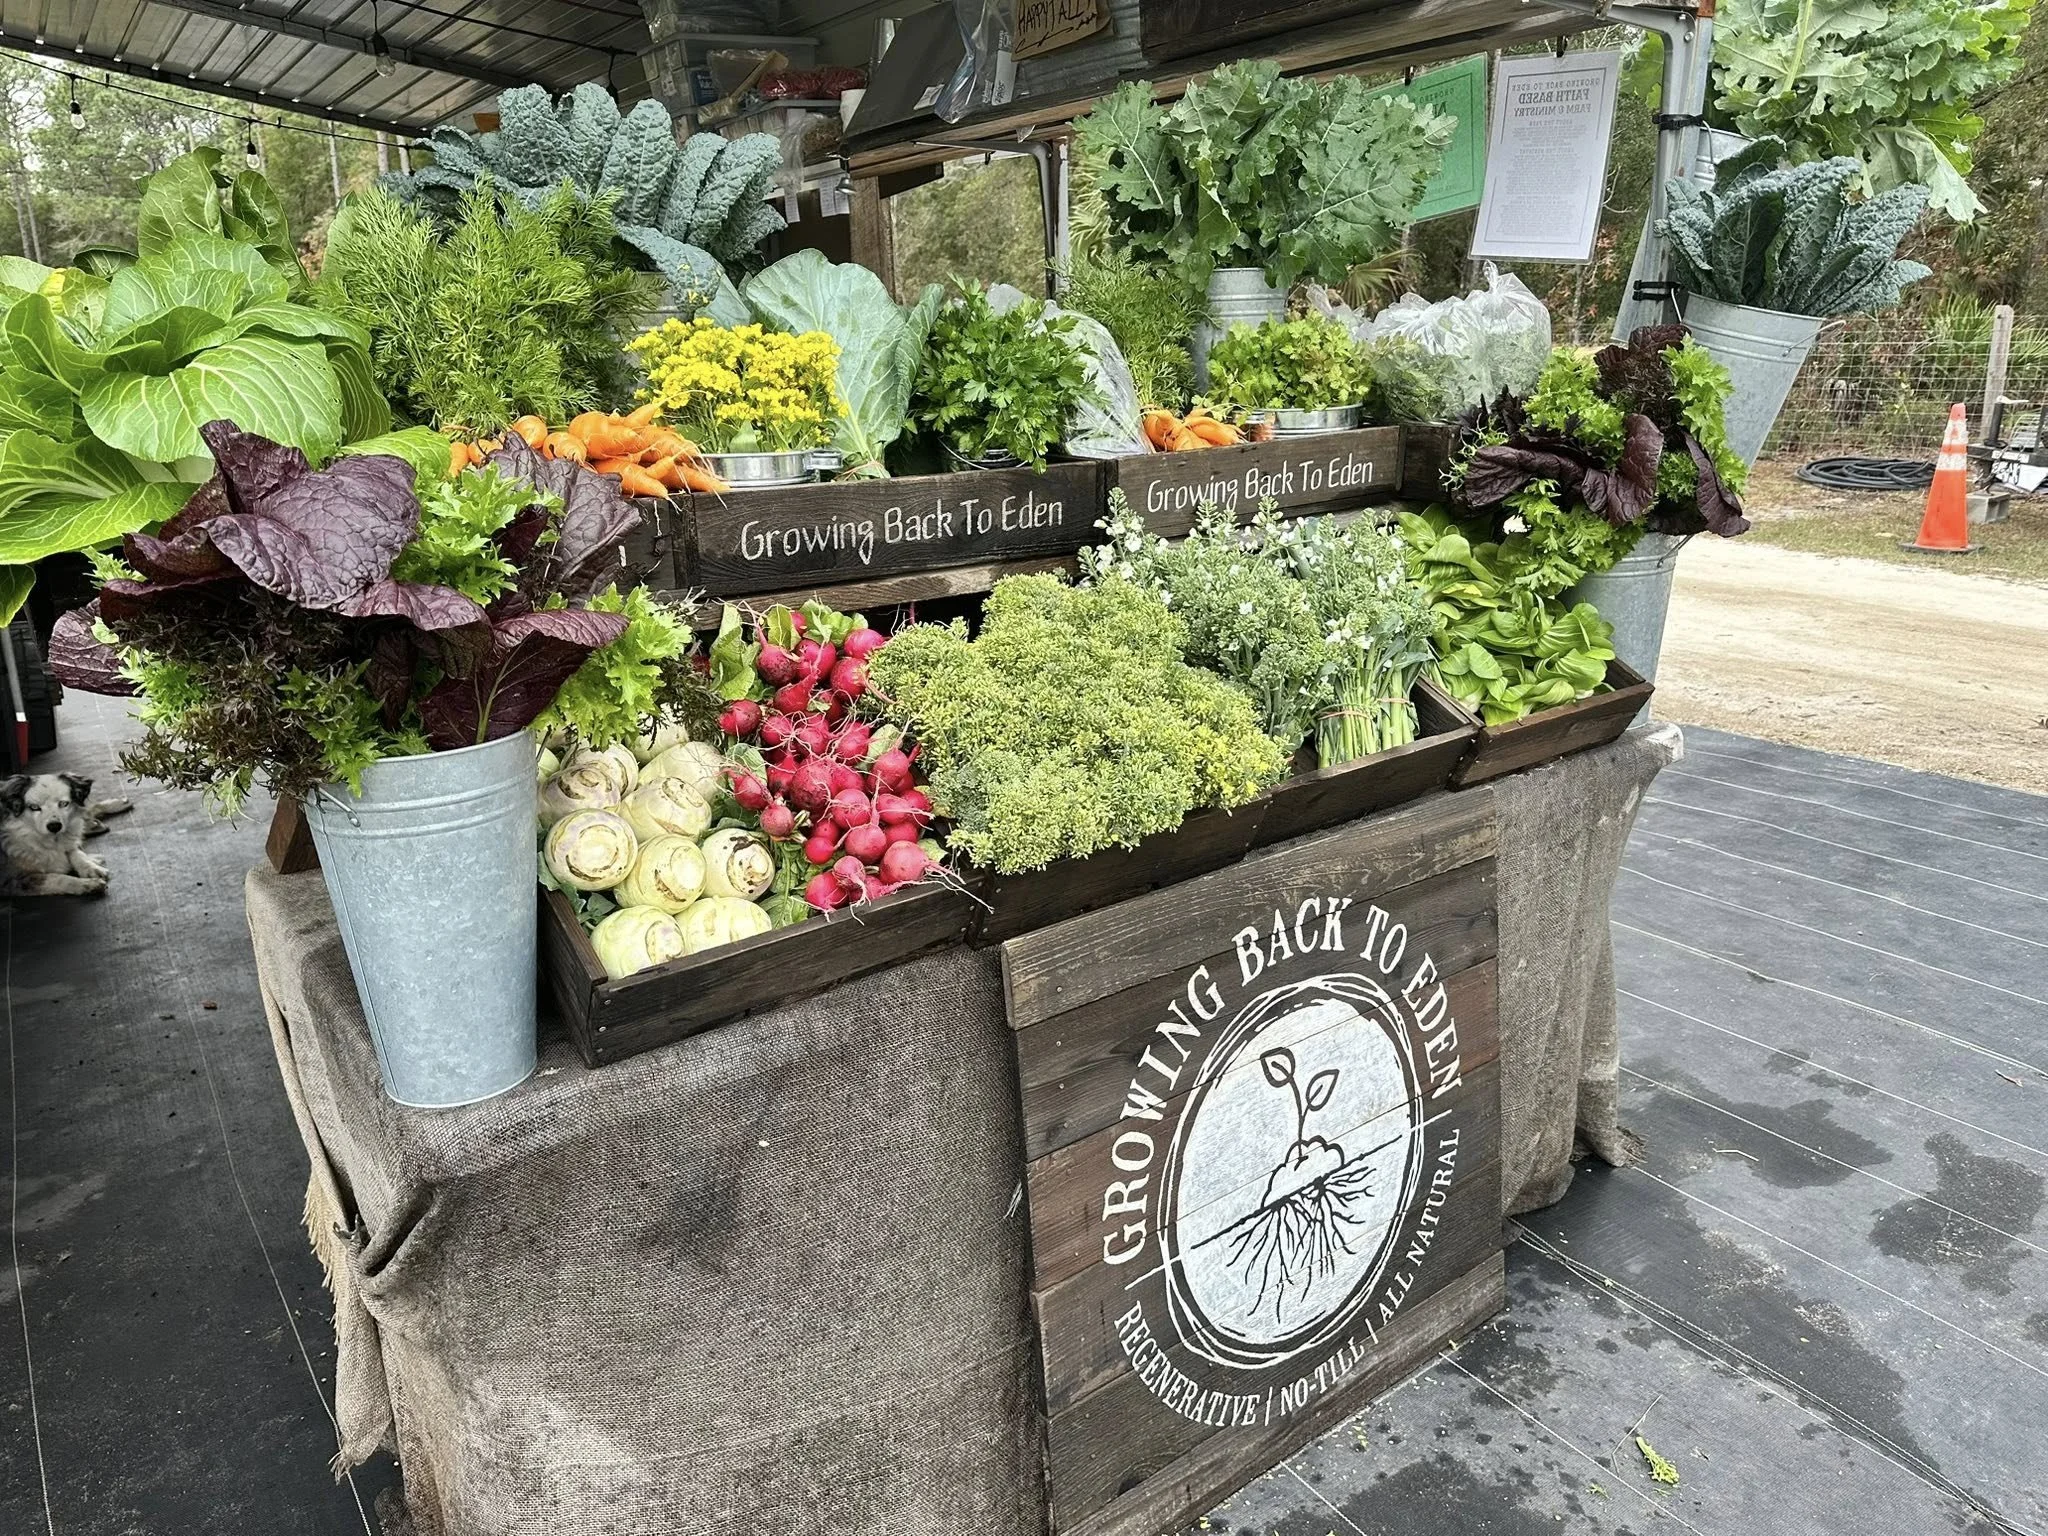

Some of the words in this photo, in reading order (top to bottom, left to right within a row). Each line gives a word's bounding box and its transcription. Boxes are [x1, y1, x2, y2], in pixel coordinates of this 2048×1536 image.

[741, 515, 874, 565] Growing
[884, 498, 954, 544] Back
[960, 498, 992, 535] To
[1001, 490, 1063, 532] Eden
[1147, 475, 1238, 512] Growing
[1245, 460, 1294, 499] Back
[1299, 460, 1323, 491] To
[1328, 453, 1373, 488] Eden
[1102, 964, 1226, 1265] GROWING
[1231, 896, 1353, 988] BACK
[1359, 904, 1408, 975] TO
[1402, 952, 1463, 1100] EDEN
[1113, 1300, 1261, 1428] REGENERATIVE
[1279, 1335, 1368, 1418] NO-TILL
[1377, 1271, 1415, 1326] ALL
[1405, 1127, 1461, 1268] NATURAL
